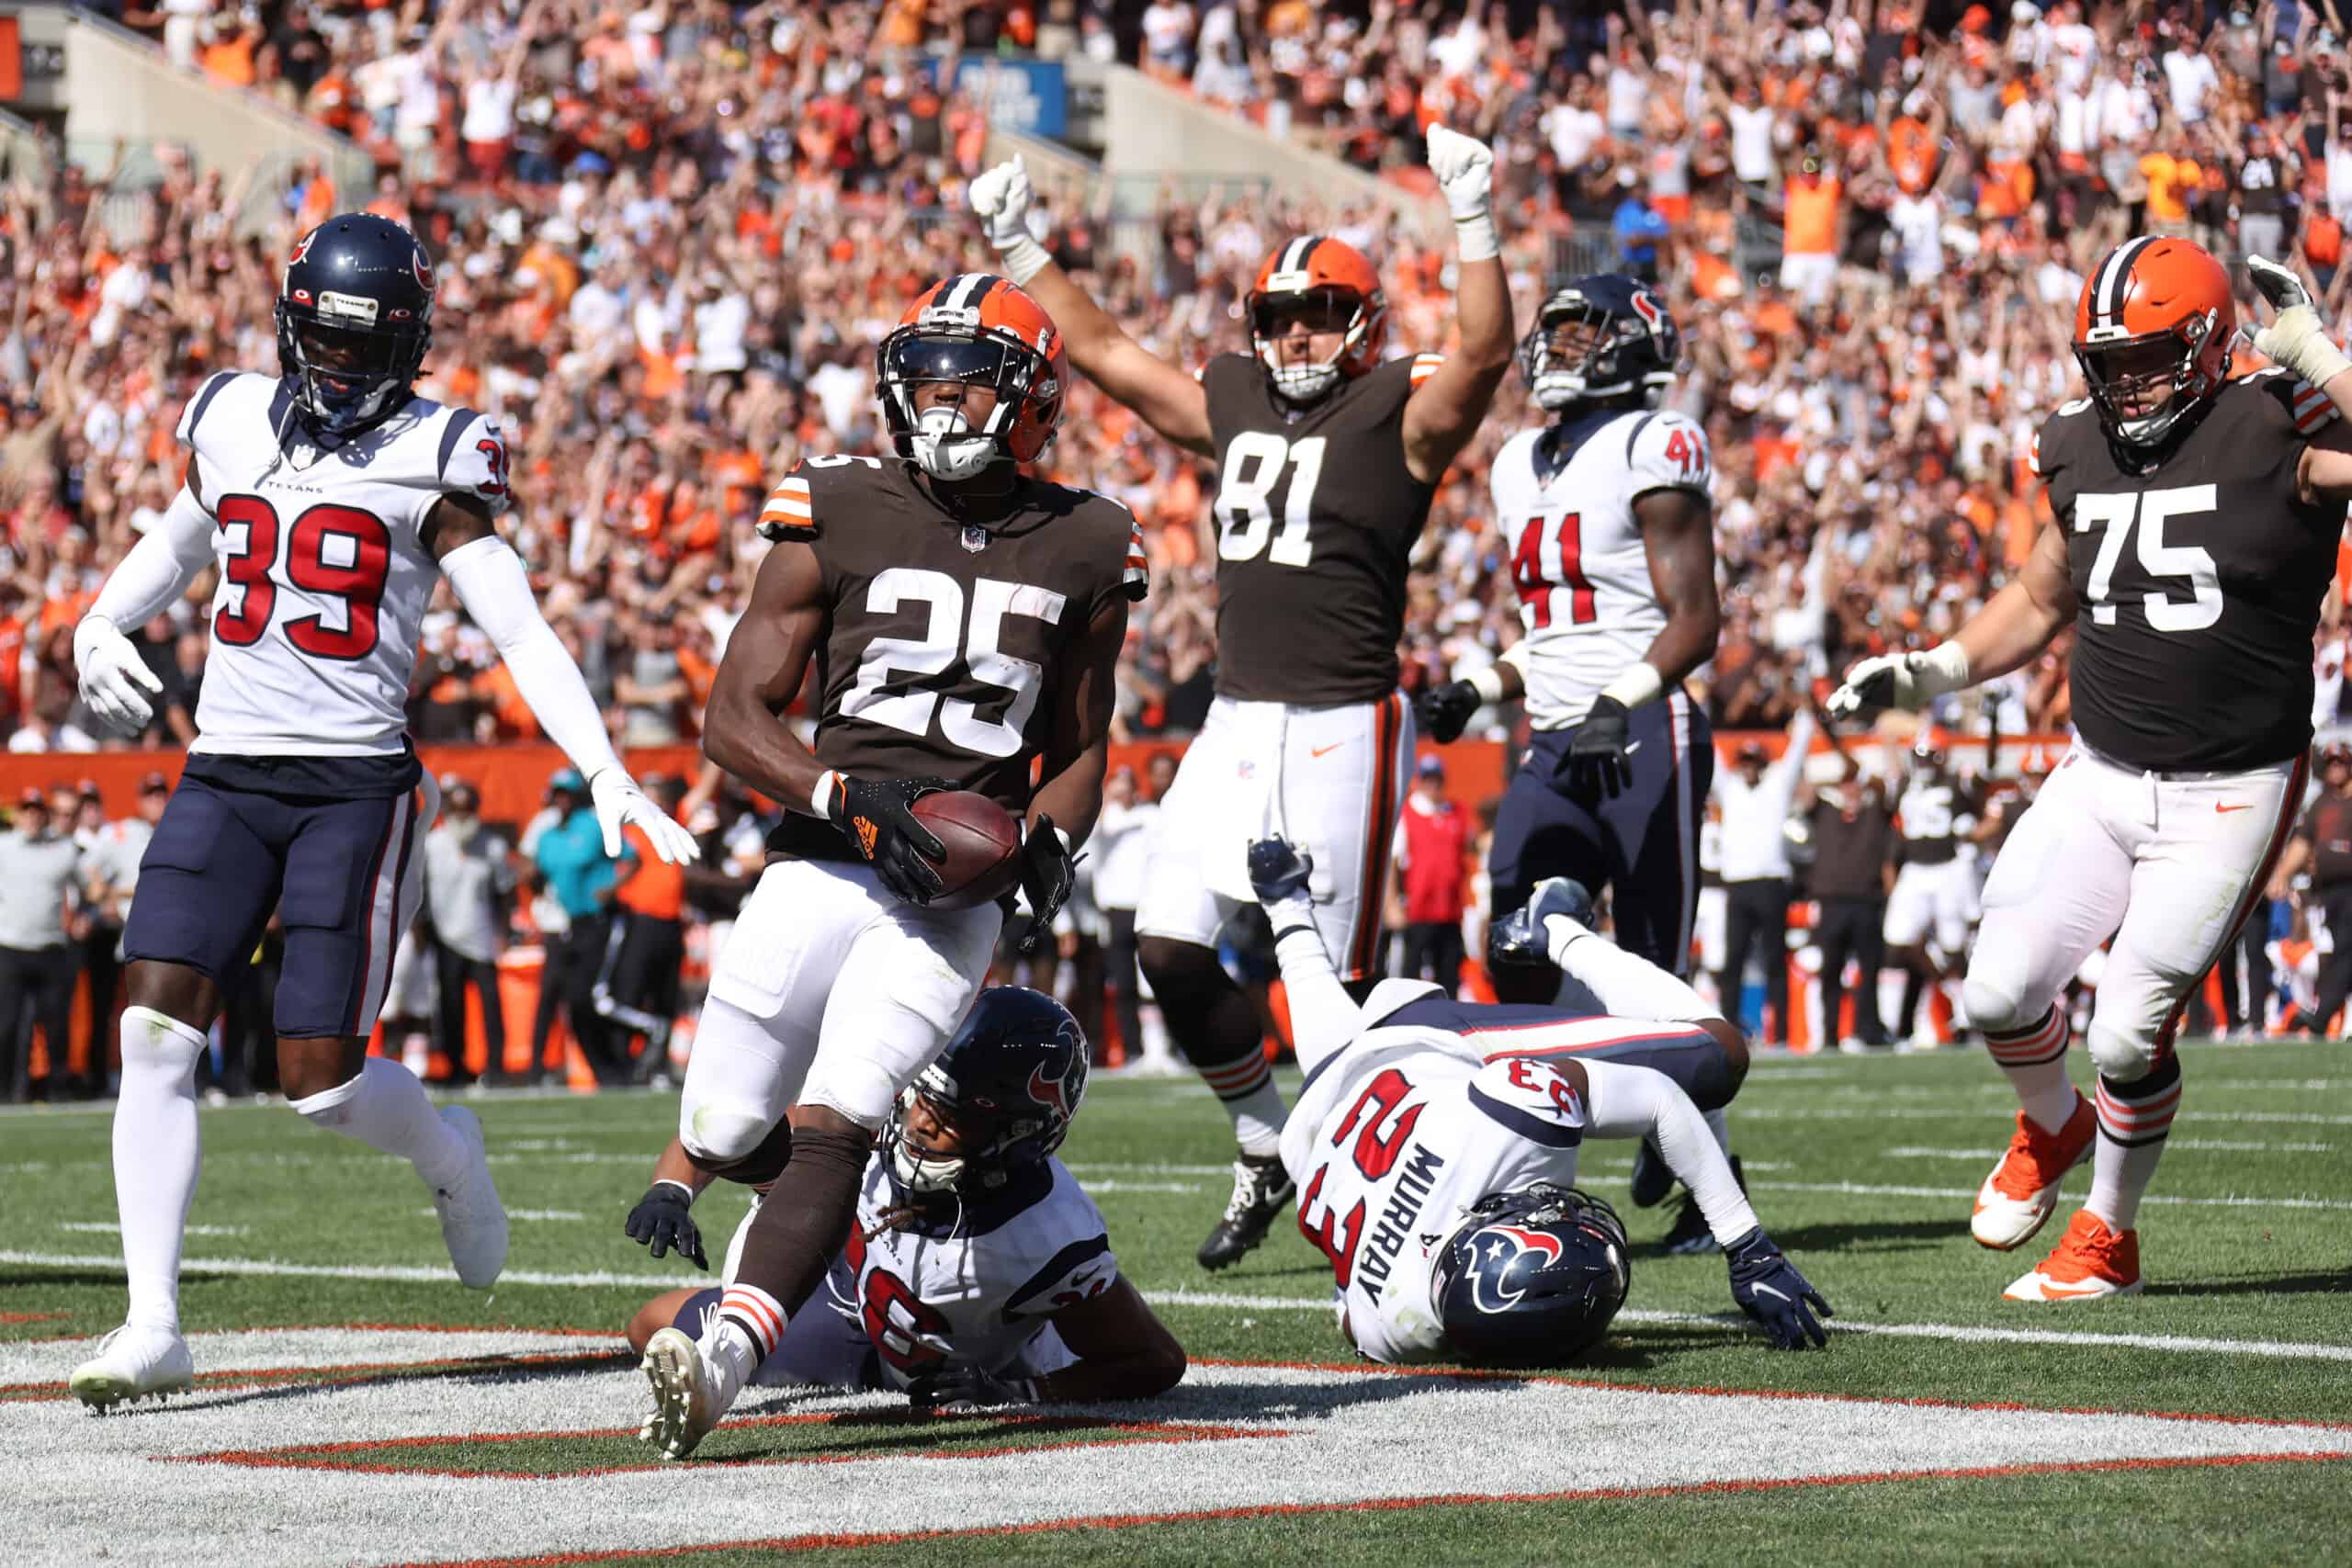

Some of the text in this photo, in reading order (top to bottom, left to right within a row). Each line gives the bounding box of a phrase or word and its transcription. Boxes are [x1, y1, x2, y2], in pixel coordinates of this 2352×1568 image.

[268, 480, 323, 494] TEXANS
[1214, 431, 1327, 568] 81
[1665, 429, 1705, 475] 41
[215, 493, 391, 660] 39
[1510, 513, 1597, 631] 41
[2074, 483, 2224, 632] 75
[839, 567, 1067, 758] 25
[1298, 1068, 1429, 1292] 23
[1355, 1143, 1445, 1309] MURRAY
